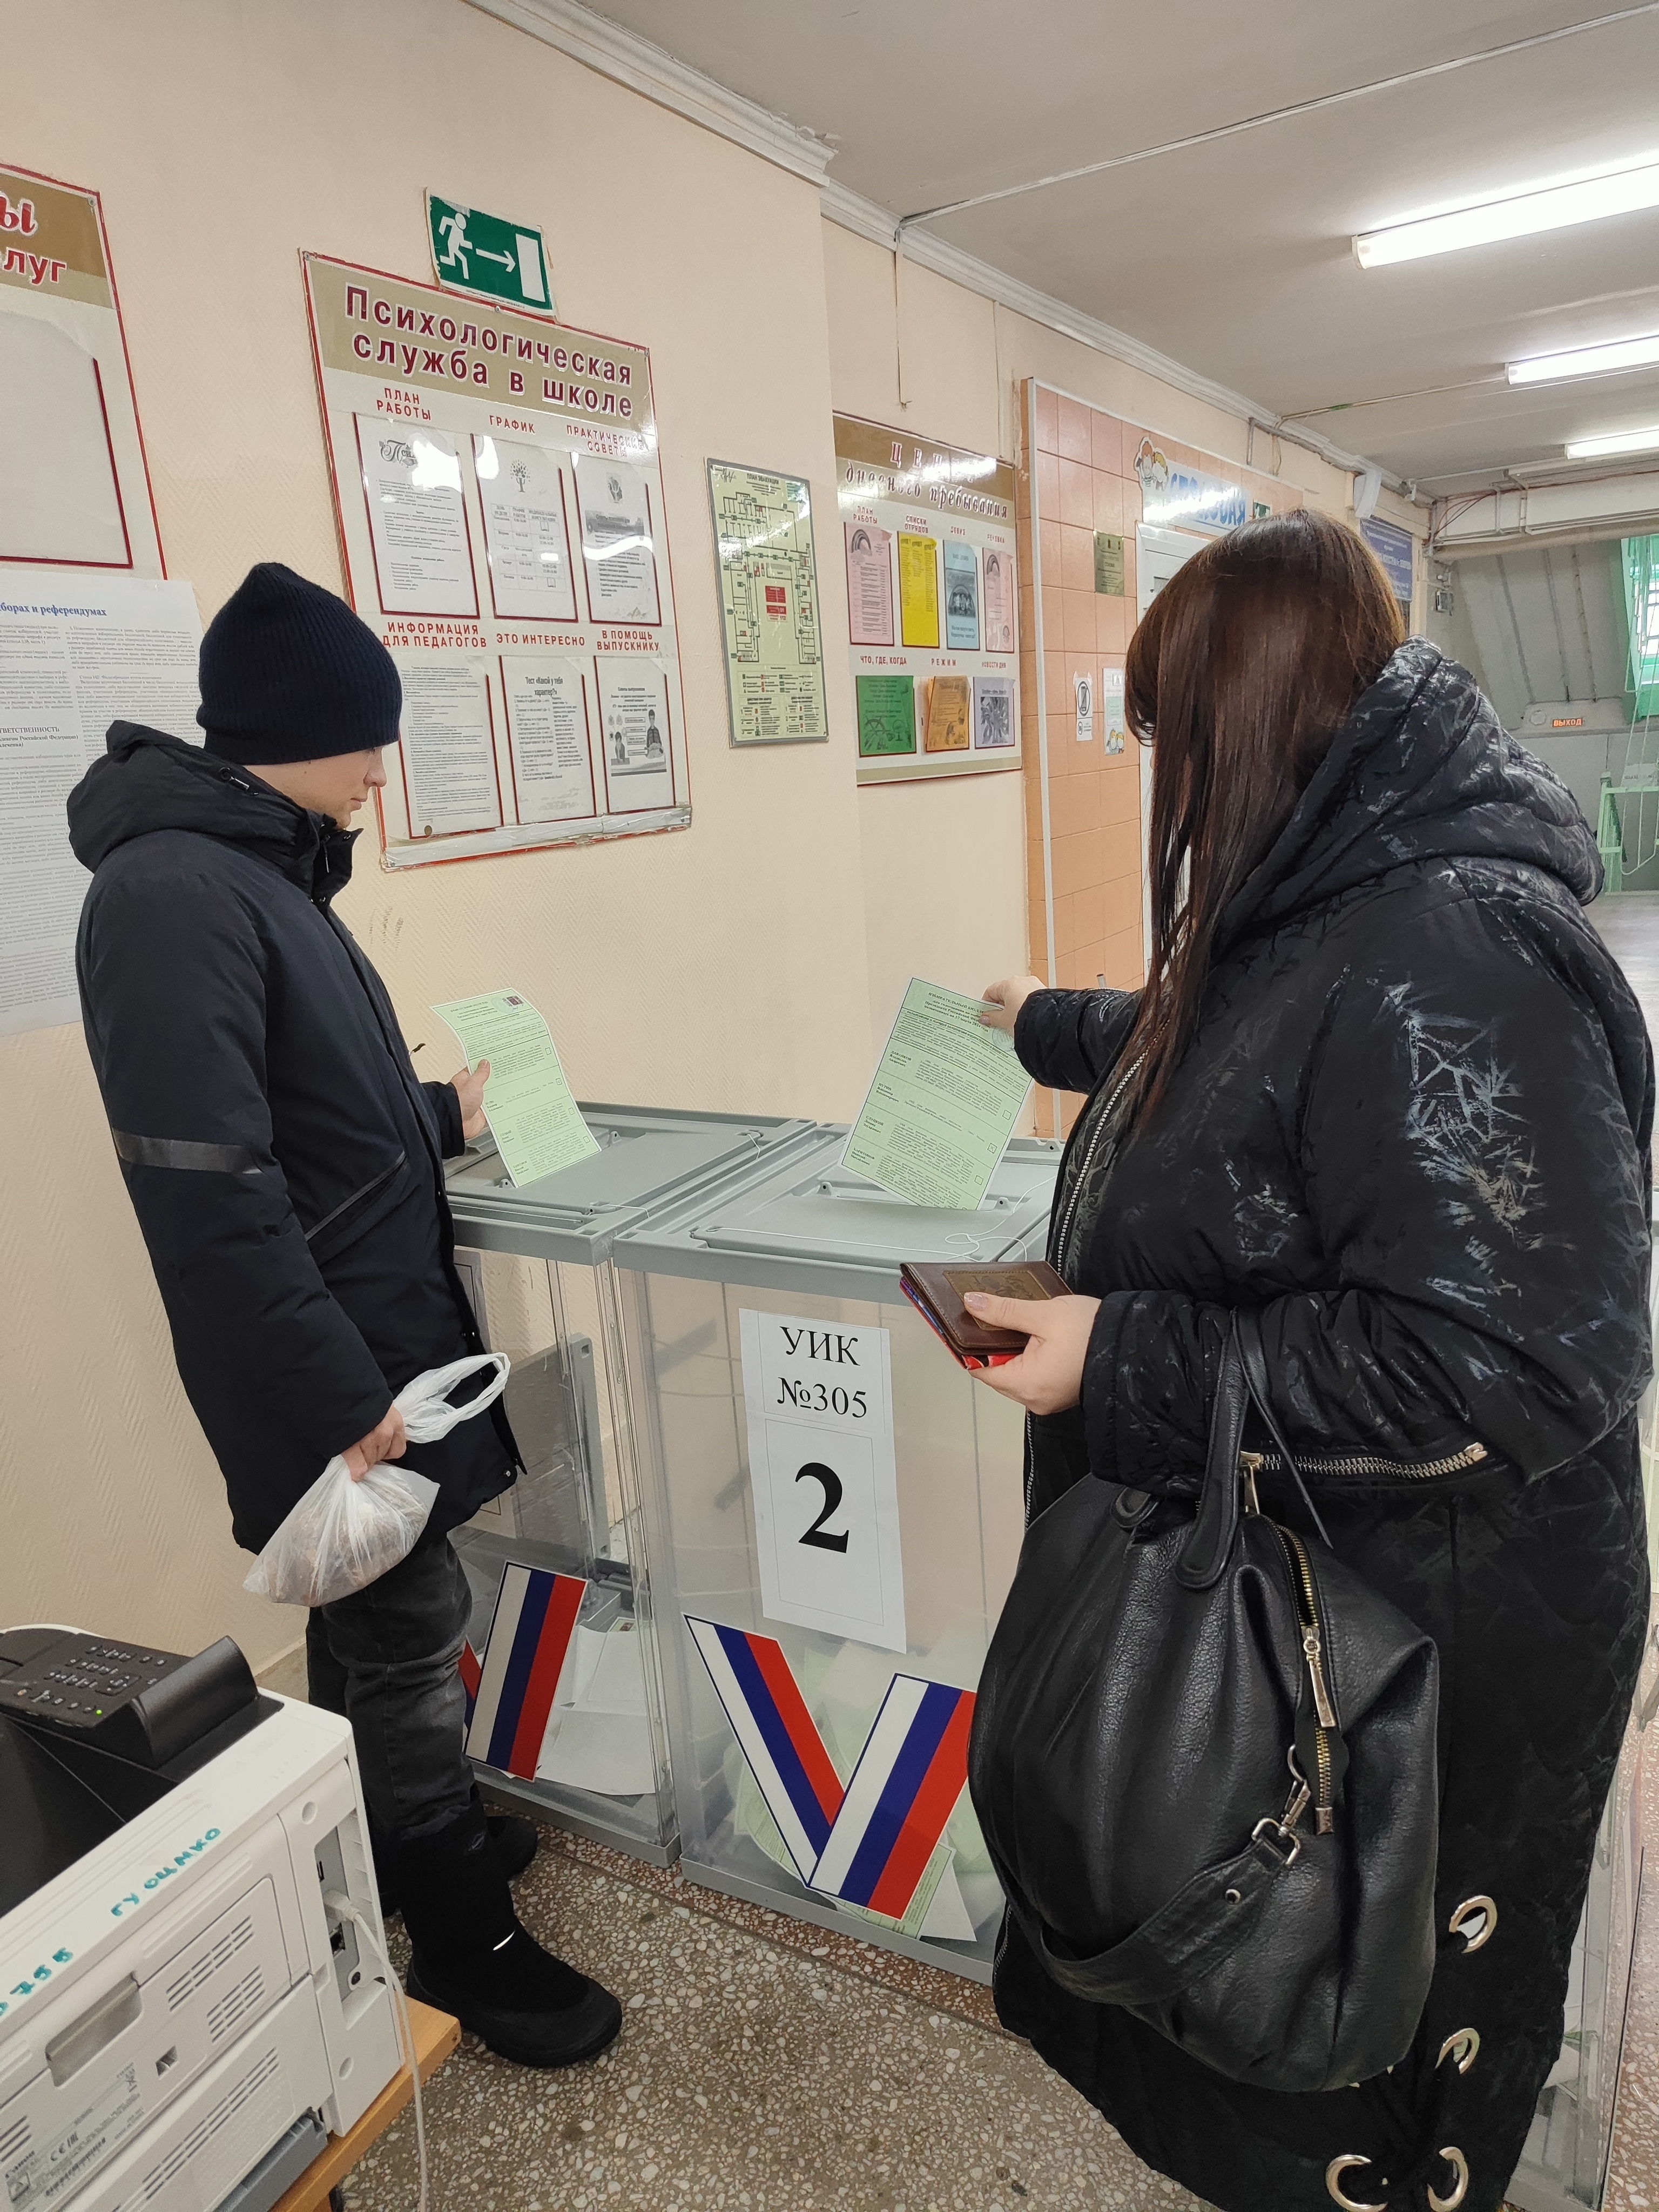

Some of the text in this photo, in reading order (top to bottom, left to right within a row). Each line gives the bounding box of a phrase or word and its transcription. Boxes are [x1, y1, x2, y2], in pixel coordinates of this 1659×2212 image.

[2, 247, 66, 286] луг
[346, 284, 632, 387] Психологическая
[353, 334, 632, 417] служба в школе
[384, 388, 420, 406] ПЛАН
[376, 400, 431, 421] РАБОТЫ
[489, 415, 535, 434] ГРАФИК
[588, 441, 626, 457] СОВЕТЫ
[929, 486, 1007, 518] пребывания
[857, 505, 873, 515] ПЛАН
[853, 514, 877, 524] РАБОТЫ
[906, 515, 927, 525] СПИСКИ
[905, 522, 928, 533] ОТРЯДОВ
[950, 526, 965, 535] ДЕВИЗ
[0, 602, 30, 615] борах
[40, 604, 107, 617] референдумах
[387, 622, 478, 636] ИНФОРМАЦИЯ
[602, 630, 652, 642] В ПОМОЩЬ
[382, 634, 487, 649] ДЛЯ ПЕДАГОГОВ
[496, 633, 585, 646] ЭТО ИНТЕРЕСНО
[597, 640, 659, 651] ВЫПУСКНИКУ
[860, 656, 907, 666] ЧТО, ГДЕ, КОГДА
[779, 1325, 860, 1366] УИК
[777, 1377, 867, 1418] №305
[794, 1462, 849, 1554] 2
